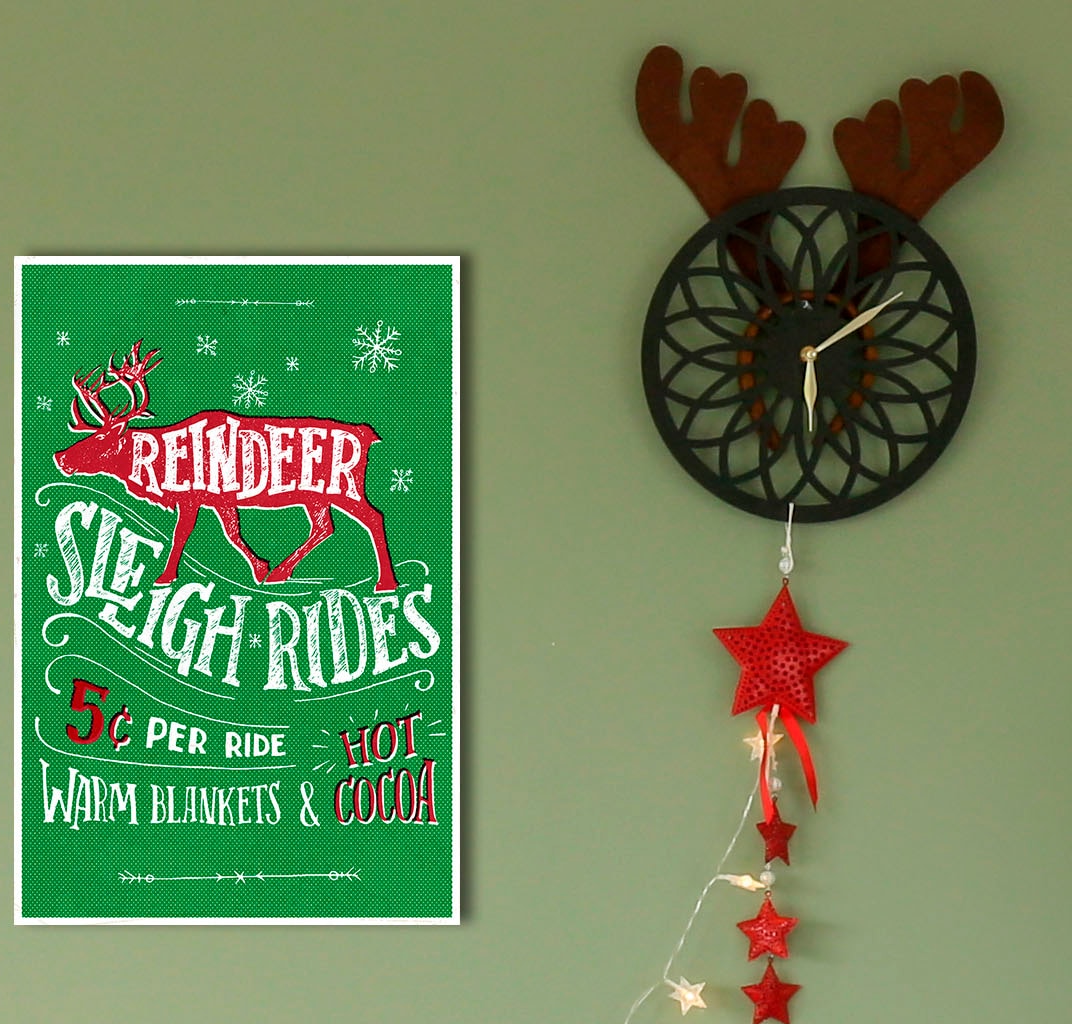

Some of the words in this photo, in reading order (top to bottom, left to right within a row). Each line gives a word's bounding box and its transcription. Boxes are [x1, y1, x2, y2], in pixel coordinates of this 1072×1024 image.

[128, 416, 362, 501] REINDEER
[46, 500, 254, 689] SLEIGH
[263, 584, 442, 693] RIDES
[65, 678, 133, 752] 5¢
[145, 717, 207, 757] PER
[225, 730, 287, 759] RIDE
[338, 711, 423, 768] HOT
[39, 758, 139, 831] WARM
[150, 780, 283, 827] BLANKETS
[299, 781, 321, 829] &
[332, 758, 439, 826] COCOA
